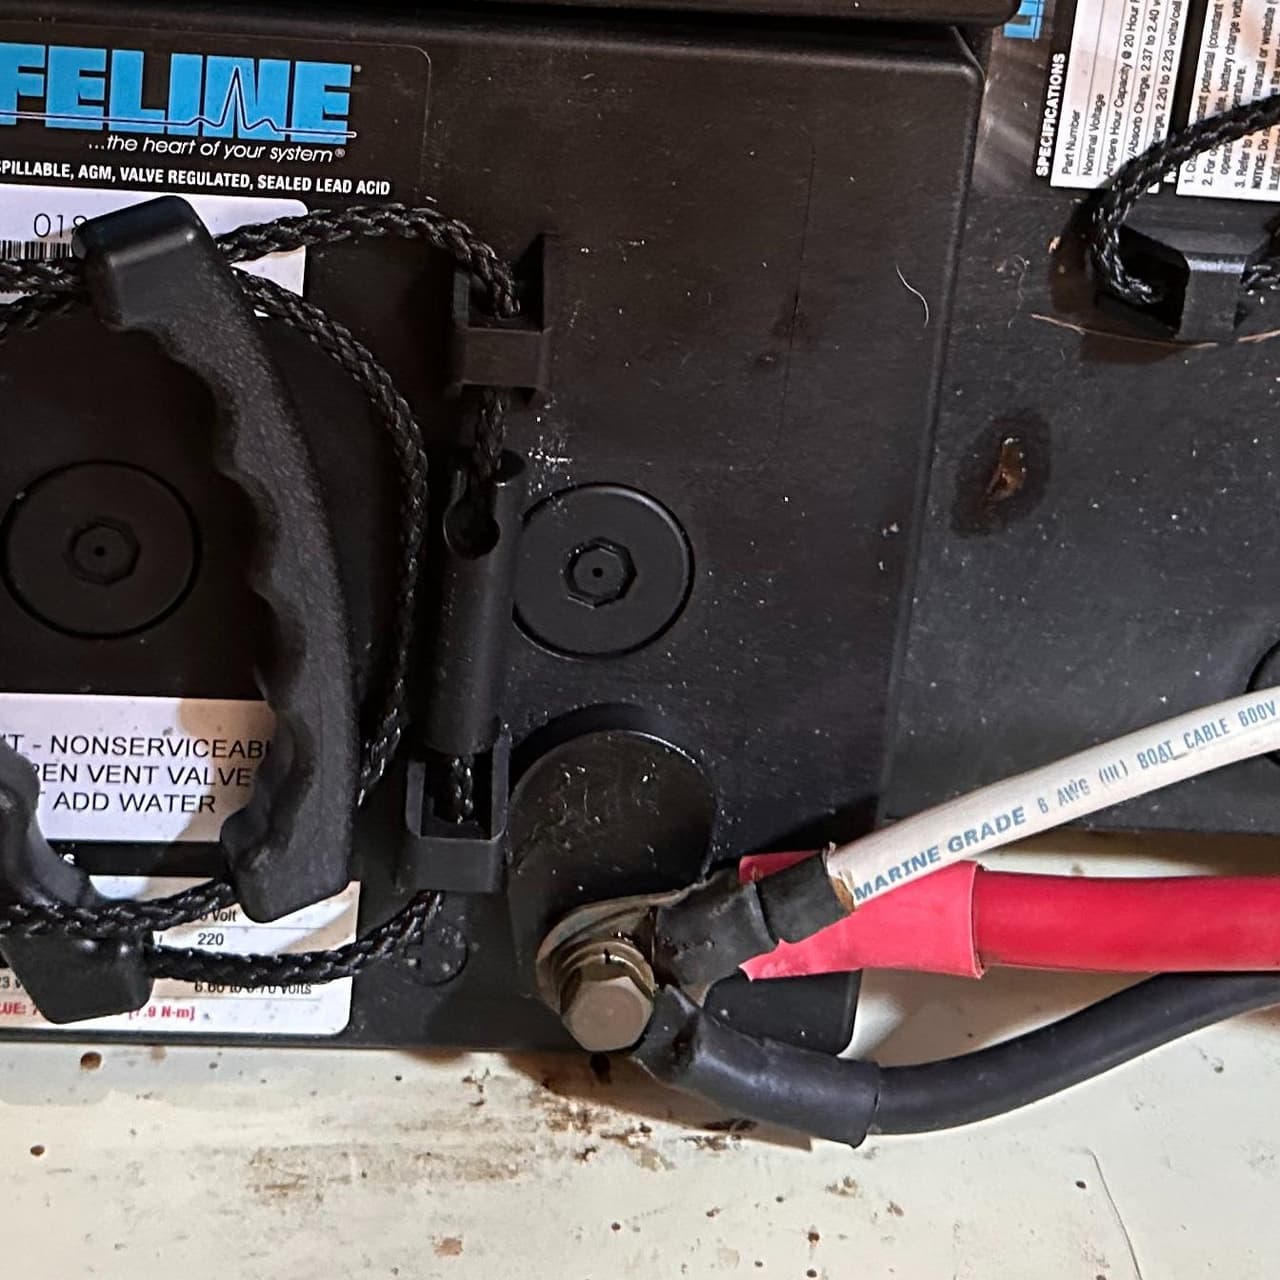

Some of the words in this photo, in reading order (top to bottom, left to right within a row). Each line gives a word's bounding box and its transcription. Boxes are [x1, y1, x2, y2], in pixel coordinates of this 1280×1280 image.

[1125, 6, 1139, 31] Hour
[1145, 8, 1160, 32] 2.40
[1206, 2, 1224, 48] (constant
[1123, 33, 1134, 48] 20
[1143, 33, 1156, 45] to
[1224, 21, 1241, 56] charge
[1139, 48, 1153, 70] 2.37
[1160, 48, 1174, 72] 2.23
[1199, 50, 1216, 93] potential
[1113, 62, 1132, 108] Capacity
[1158, 74, 1170, 85] to
[1217, 58, 1234, 92] battery
[1133, 71, 1152, 114] Charge,
[1154, 87, 1168, 110] 2.20
[1237, 149, 1250, 176] Refer
[1260, 7, 1274, 45] website
[1034, 52, 1066, 176] SPECIFICATIONS
[1088, 93, 1106, 132] Voltage
[1109, 110, 1122, 135] Hour
[1065, 110, 1081, 151] Number
[142, 137, 195, 155] heart
[199, 140, 223, 156] of
[224, 143, 265, 161] your
[1061, 152, 1074, 174] Part
[1081, 133, 1098, 176] Nominal
[1102, 137, 1120, 177] Ampere
[77, 164, 116, 182] AGM,
[119, 167, 163, 182] VALVE
[167, 169, 253, 190] REGULATED,
[257, 174, 312, 191] SEALED
[315, 177, 352, 193] LEAD
[355, 180, 390, 195] ACID
[1251, 152, 1266, 189] NOTICE:
[88, 762, 159, 785] VENT
[165, 764, 251, 787] VALVE
[52, 791, 109, 811] ADD
[118, 791, 215, 815] WATER
[853, 846, 941, 901] MARINE
[948, 805, 1026, 853] GRADE
[1037, 797, 1050, 815] 6
[1056, 779, 1092, 807] AWG
[1136, 740, 1176, 771] BOAT
[1183, 718, 1228, 750] CABLE
[1237, 700, 1277, 727] 600V
[197, 932, 223, 946] 220
